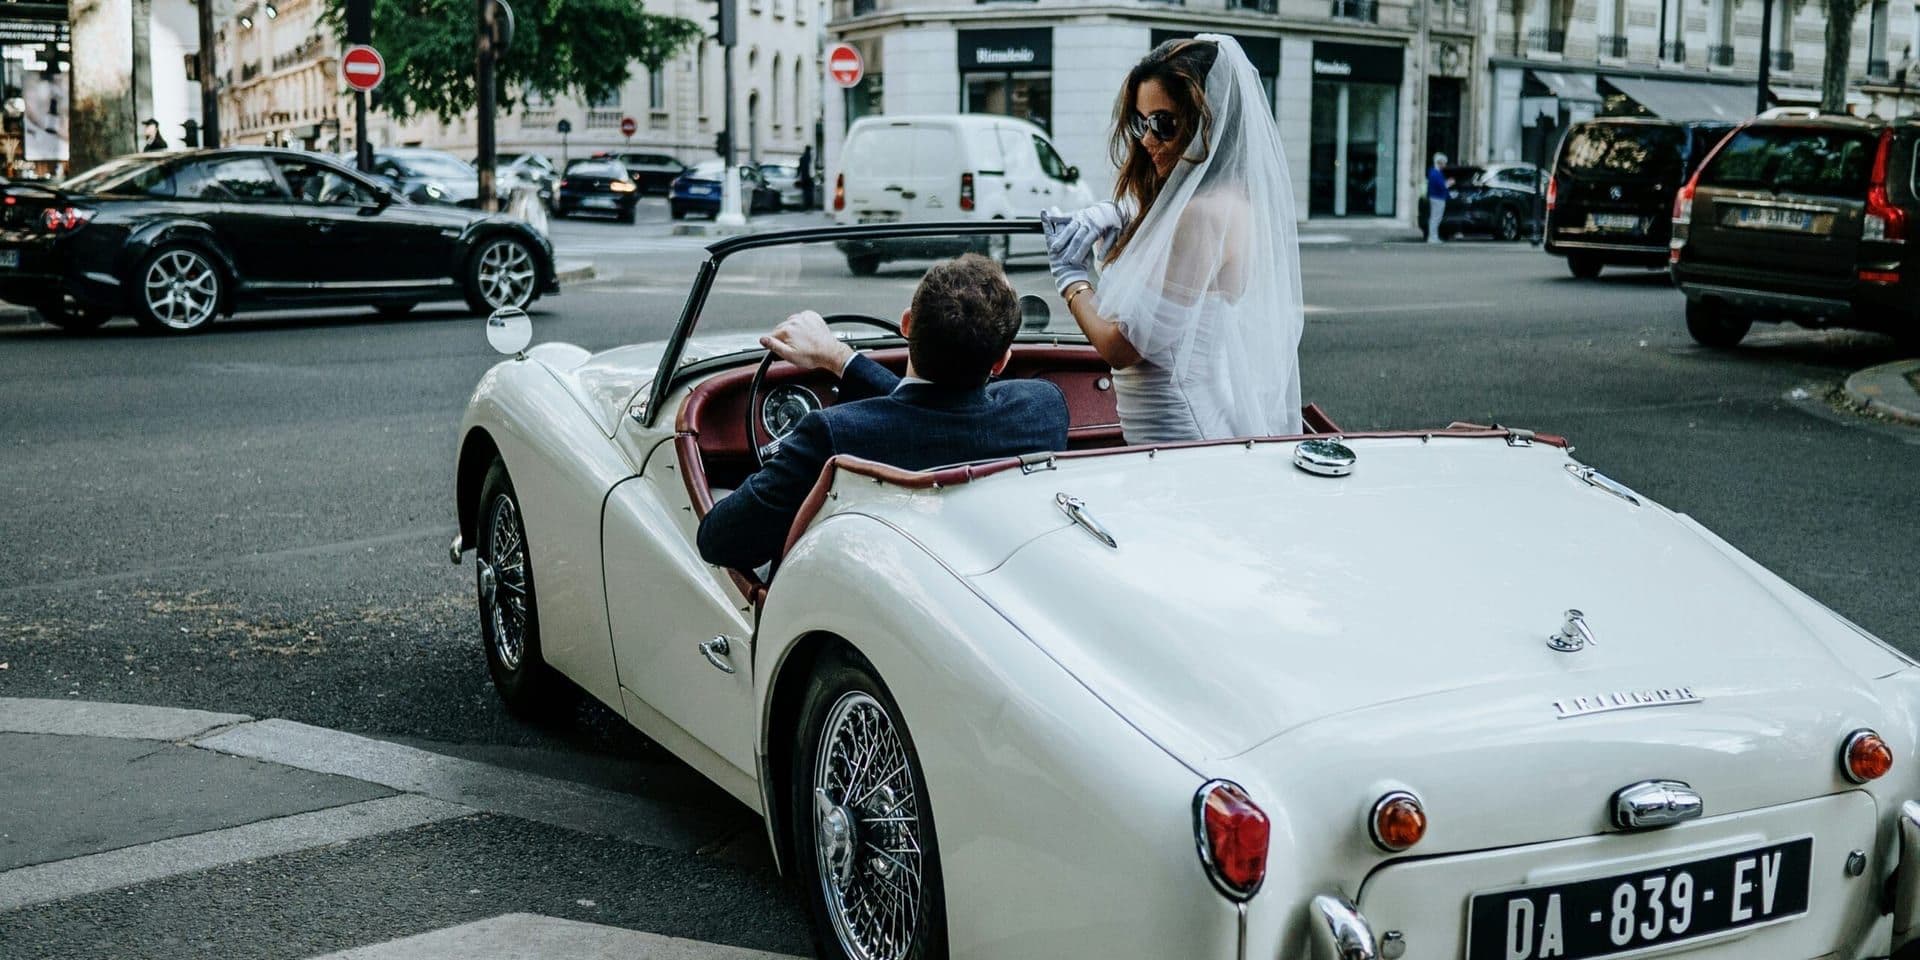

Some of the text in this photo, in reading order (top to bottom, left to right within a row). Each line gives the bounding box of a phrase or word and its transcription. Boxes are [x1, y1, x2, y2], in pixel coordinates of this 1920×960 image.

[1553, 687, 1698, 714] TRIUMPH
[1506, 894, 1564, 960] DA
[1731, 851, 1782, 922] EV
